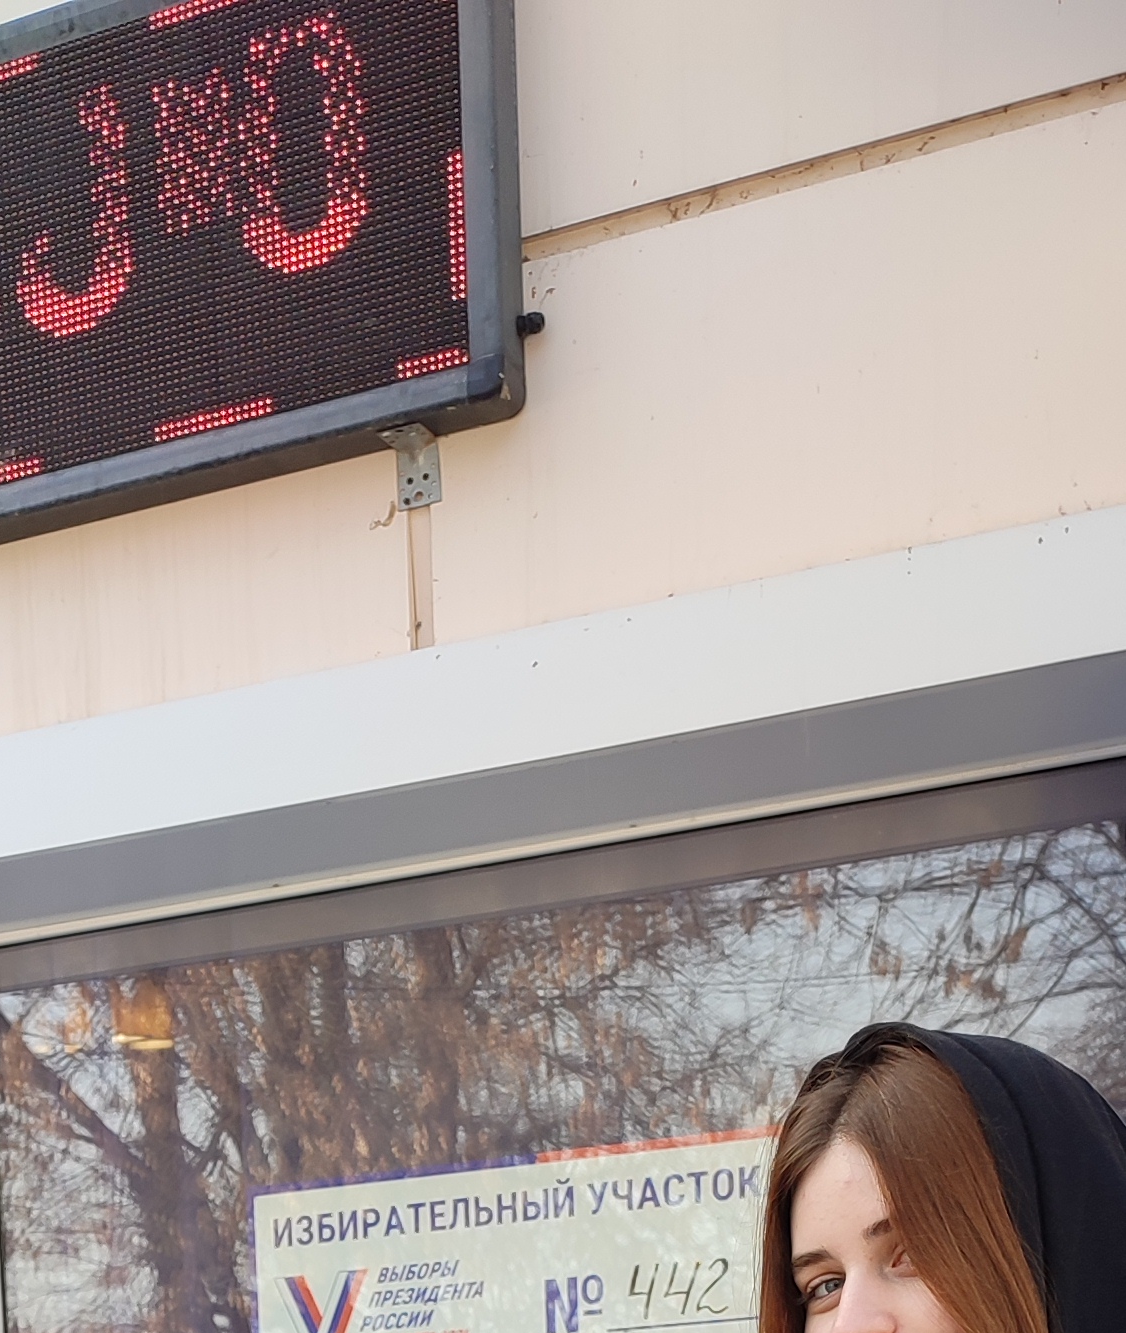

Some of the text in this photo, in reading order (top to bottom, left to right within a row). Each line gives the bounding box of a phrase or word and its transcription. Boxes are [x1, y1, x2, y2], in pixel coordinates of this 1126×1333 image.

[274, 1165, 761, 1248] ИЗБИРАТЕЛЬНЫЙ УЧАСТОК
[377, 1259, 460, 1284] ВЫБОРЫ
[368, 1281, 484, 1308] ПРЕЗИДЕНТА
[628, 1257, 729, 1320] 442
[360, 1310, 434, 1332] РОССИИ
